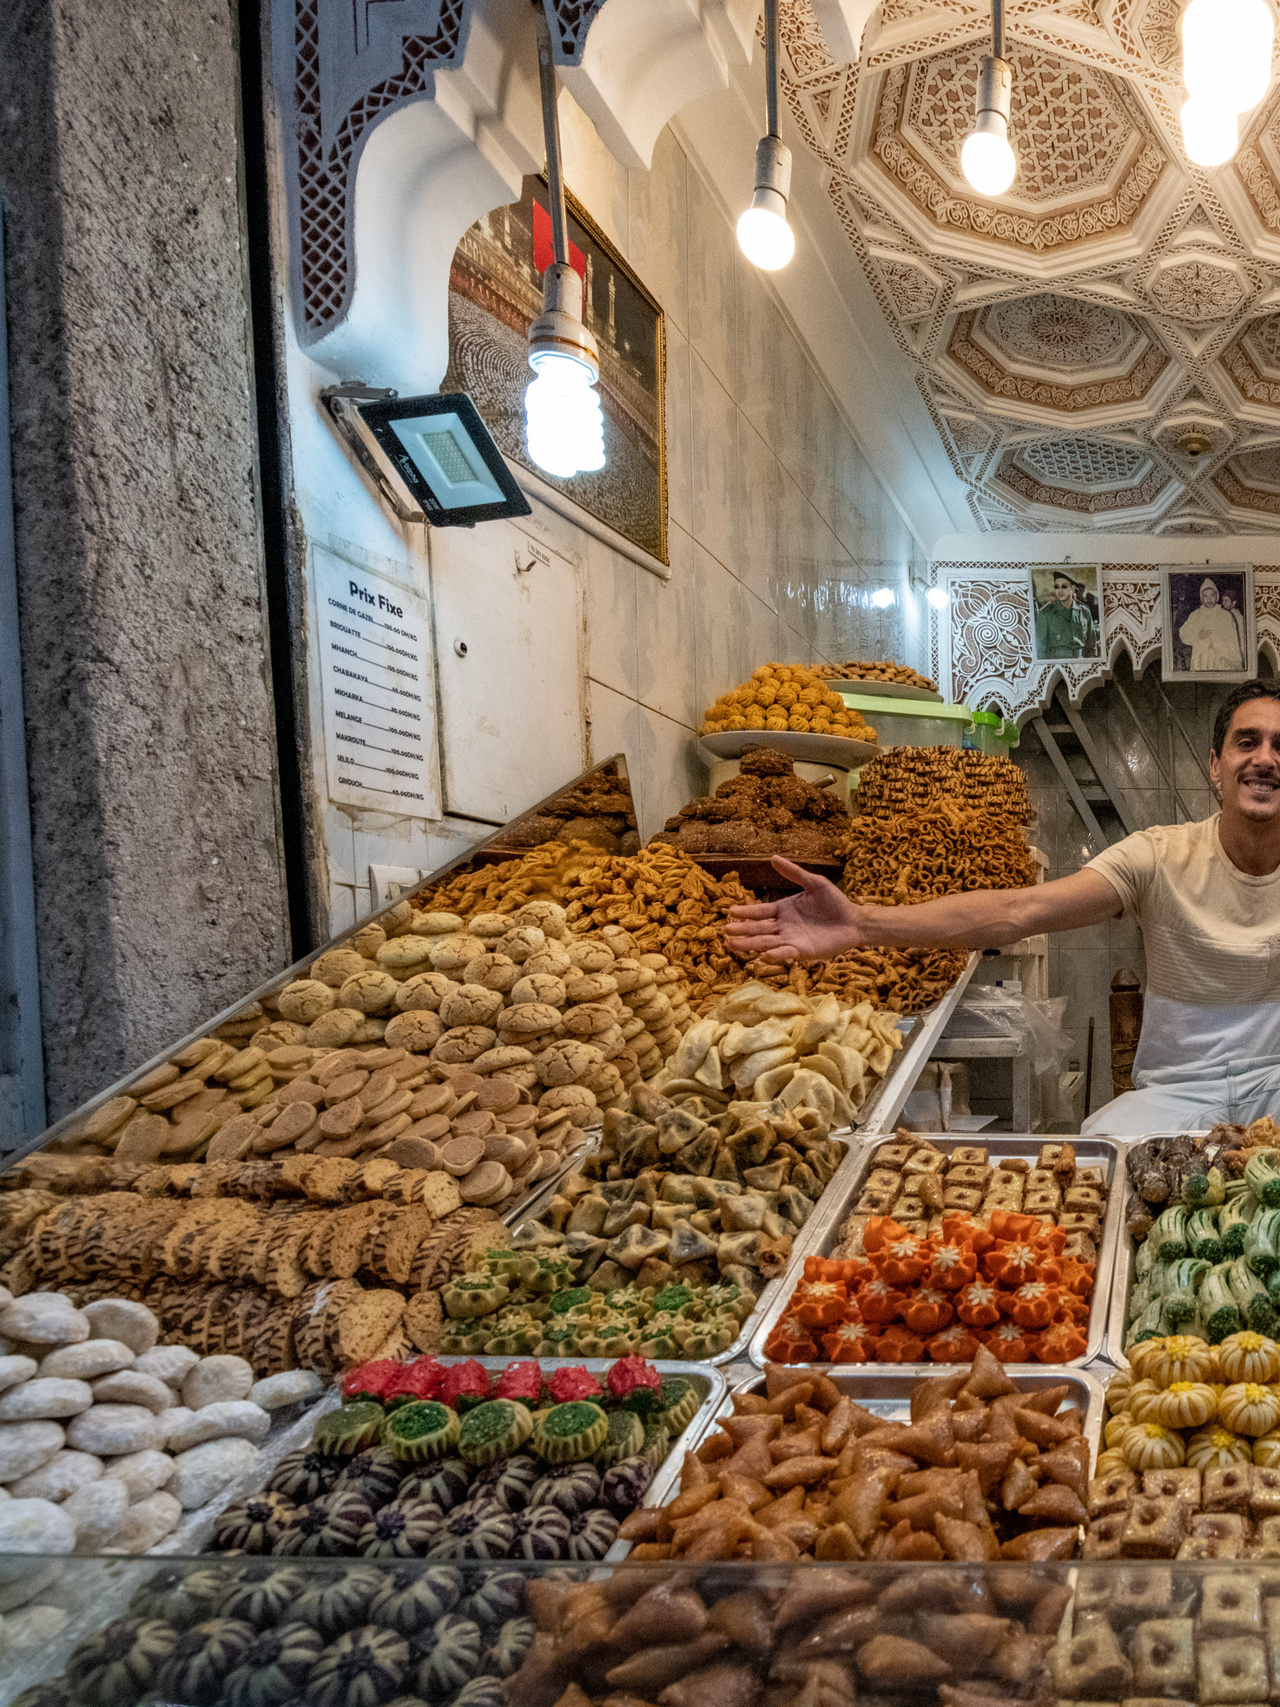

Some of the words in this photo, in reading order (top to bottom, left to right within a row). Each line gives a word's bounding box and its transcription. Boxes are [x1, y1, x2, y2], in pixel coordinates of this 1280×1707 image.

[327, 598, 348, 613] CORNE
[349, 606, 356, 615] DE
[349, 580, 376, 606] Prix
[378, 593, 404, 619] Fixe
[330, 620, 361, 638] BRIOUATTE
[331, 643, 358, 658] MHANCH
[335, 710, 362, 724] MELANGE
[335, 732, 366, 746] MAKROUTE
